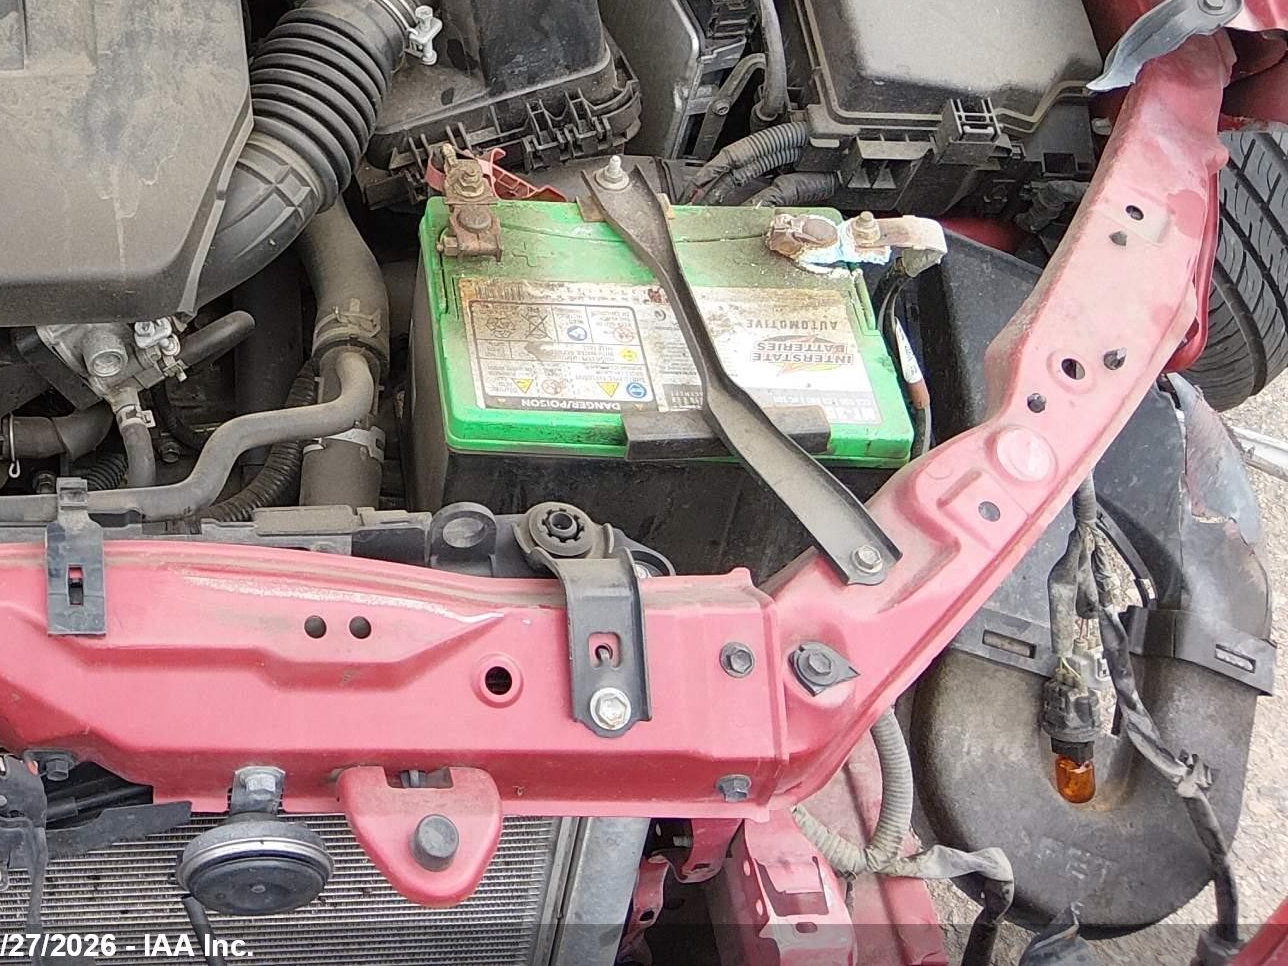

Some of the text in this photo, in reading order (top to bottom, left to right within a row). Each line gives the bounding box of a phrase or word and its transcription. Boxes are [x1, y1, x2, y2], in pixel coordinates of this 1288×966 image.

[746, 319, 838, 331] AUTOMOTIVE
[757, 342, 846, 353] BATTERIES
[752, 352, 852, 364] INTERSTATE
[520, 398, 621, 411] DANGER/POISON
